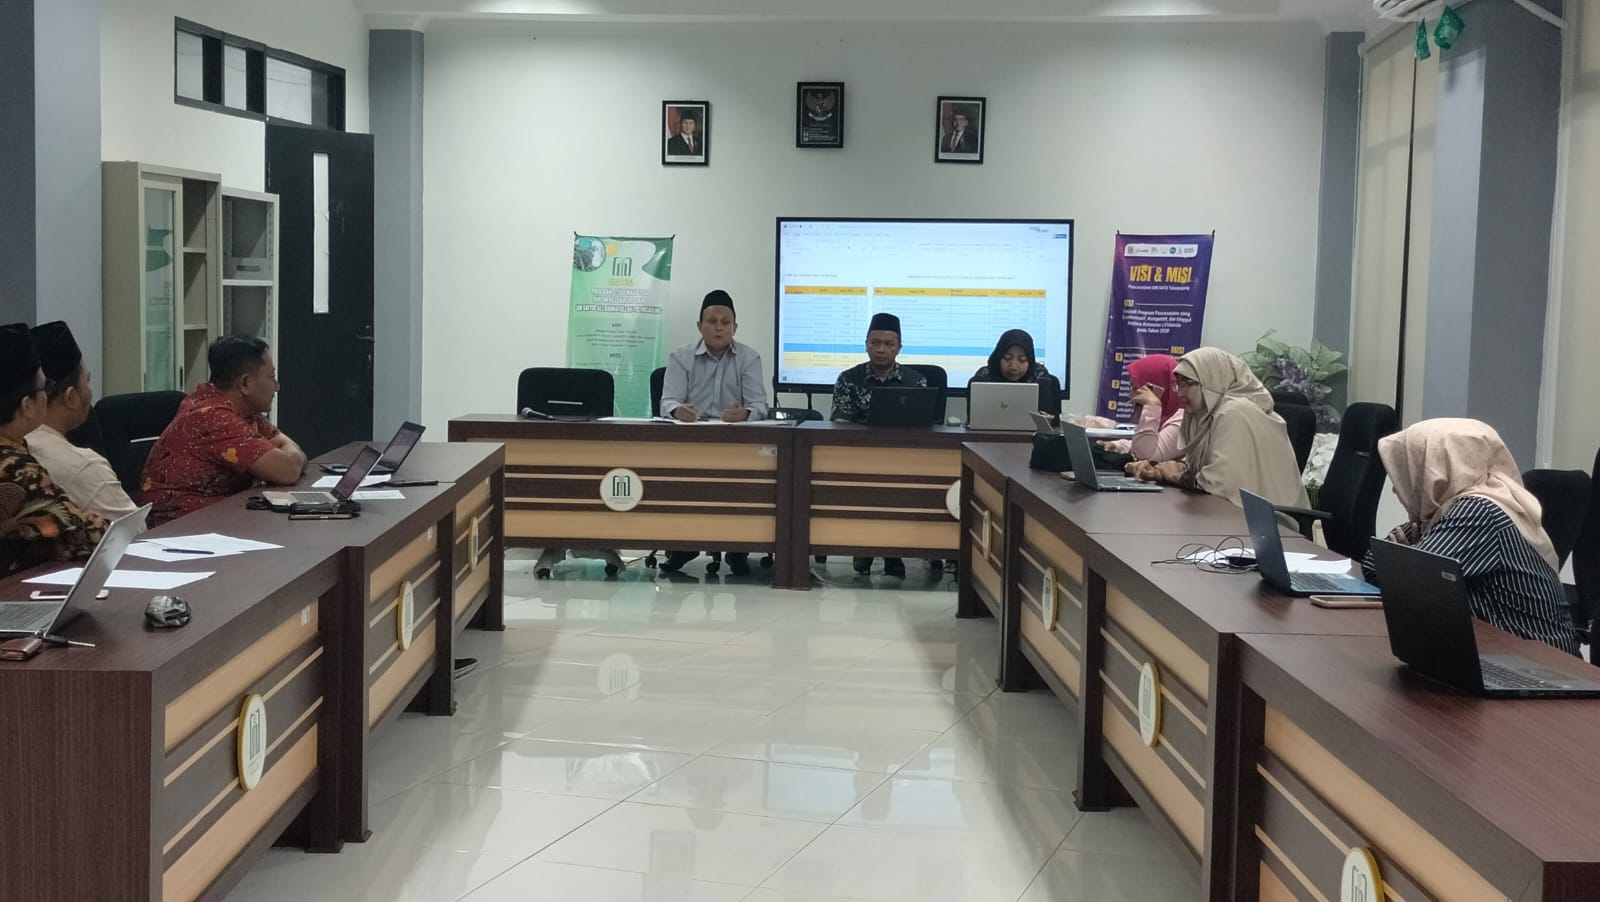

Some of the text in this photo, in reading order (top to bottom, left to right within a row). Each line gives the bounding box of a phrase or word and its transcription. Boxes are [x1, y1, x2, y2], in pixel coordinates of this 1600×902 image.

[1129, 264, 1192, 284] VISI & MISI
